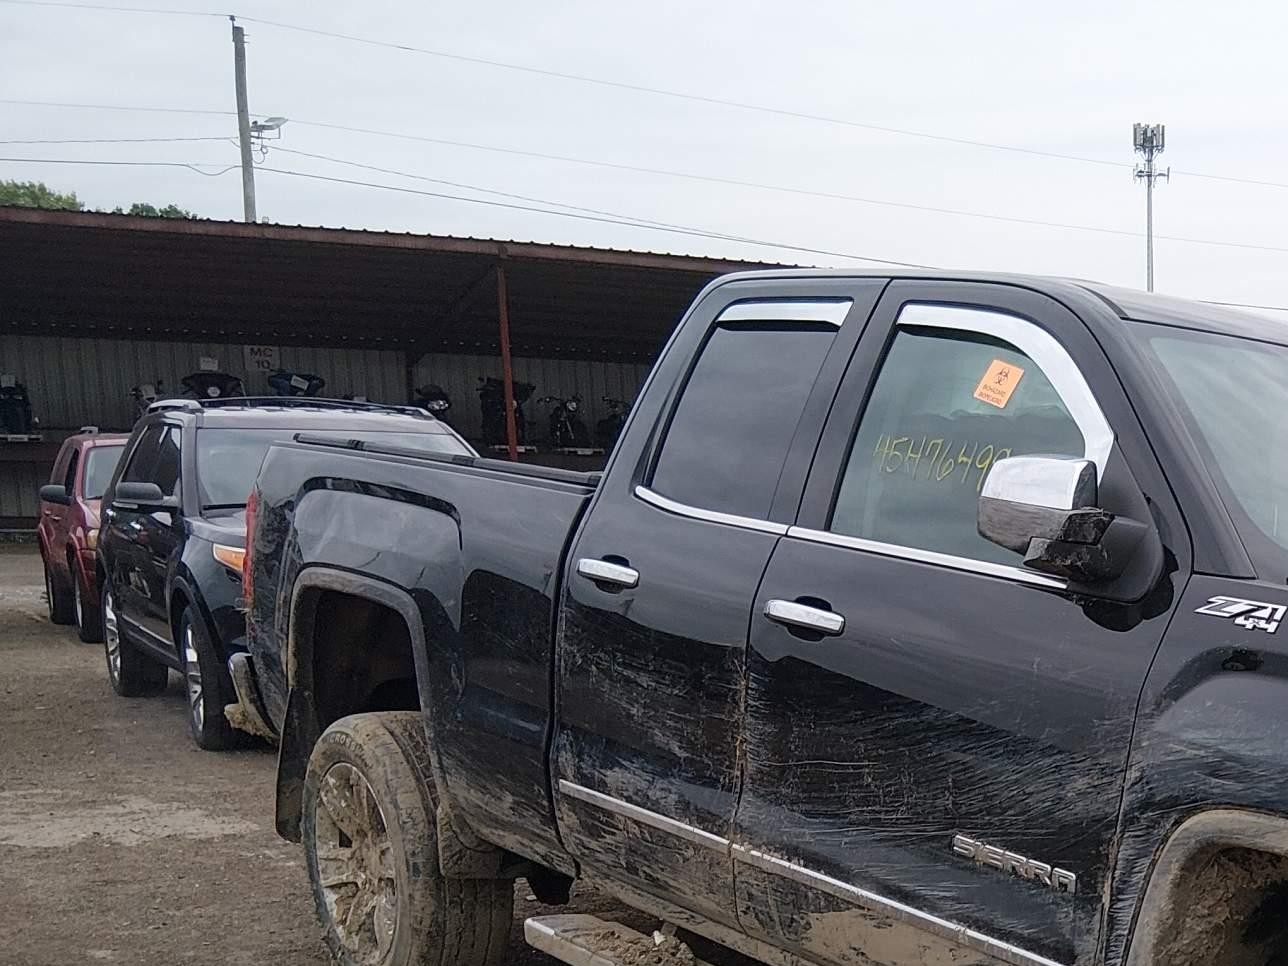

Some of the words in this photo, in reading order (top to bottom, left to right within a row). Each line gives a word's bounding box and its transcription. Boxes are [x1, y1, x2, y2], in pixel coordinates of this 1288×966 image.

[250, 347, 273, 358] MC
[255, 360, 271, 370] 10
[953, 834, 1076, 894] SIERRA
